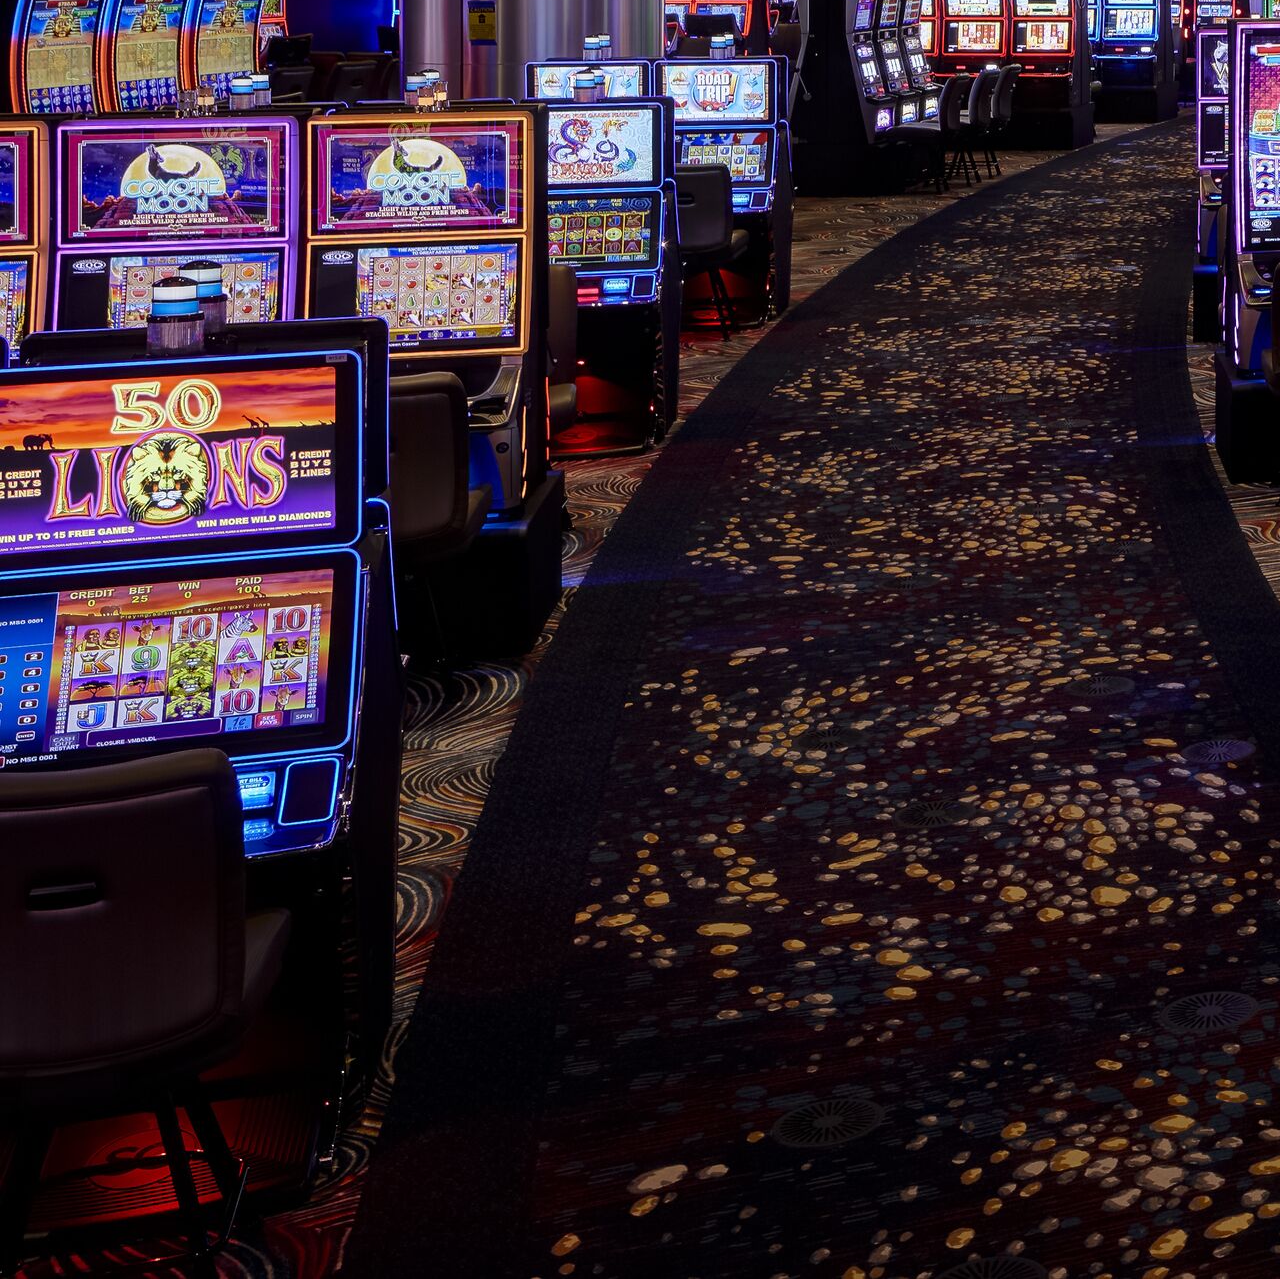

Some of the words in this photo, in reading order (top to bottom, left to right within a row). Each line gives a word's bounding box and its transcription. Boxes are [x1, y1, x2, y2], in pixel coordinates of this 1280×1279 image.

[697, 73, 730, 86] ROAD
[697, 87, 729, 103] TRIP
[552, 164, 559, 176] 5
[560, 163, 613, 176] DRAGONS
[122, 178, 226, 197] COYOTE
[368, 172, 466, 190] COYOTE
[136, 196, 209, 213] MOON
[382, 190, 450, 206] MOON
[111, 379, 221, 434] 50
[298, 449, 331, 460] CREDIT
[290, 458, 331, 469] BUYS
[6, 470, 42, 481] CREDIT
[290, 470, 298, 478] 2
[300, 467, 331, 478] LINES
[7, 487, 42, 499] LINES
[196, 519, 218, 529] WIN
[219, 517, 249, 527] MORE
[251, 514, 276, 524] WILD
[278, 511, 332, 522] DIAMONDS
[18, 534, 34, 542] UP
[36, 532, 51, 541] TO
[53, 531, 66, 539] 15
[68, 529, 95, 538] FREE
[97, 526, 135, 536] GAMES
[70, 589, 114, 600] CREDIT
[129, 586, 153, 595] BET
[178, 581, 200, 591] WIN
[235, 576, 262, 586] PAID
[87, 599, 96, 607] 0
[131, 594, 148, 604] 25
[184, 591, 192, 599] 0
[236, 585, 261, 594] 100
[50, 744, 80, 752] RESTART
[96, 739, 125, 747] CLOSURE
